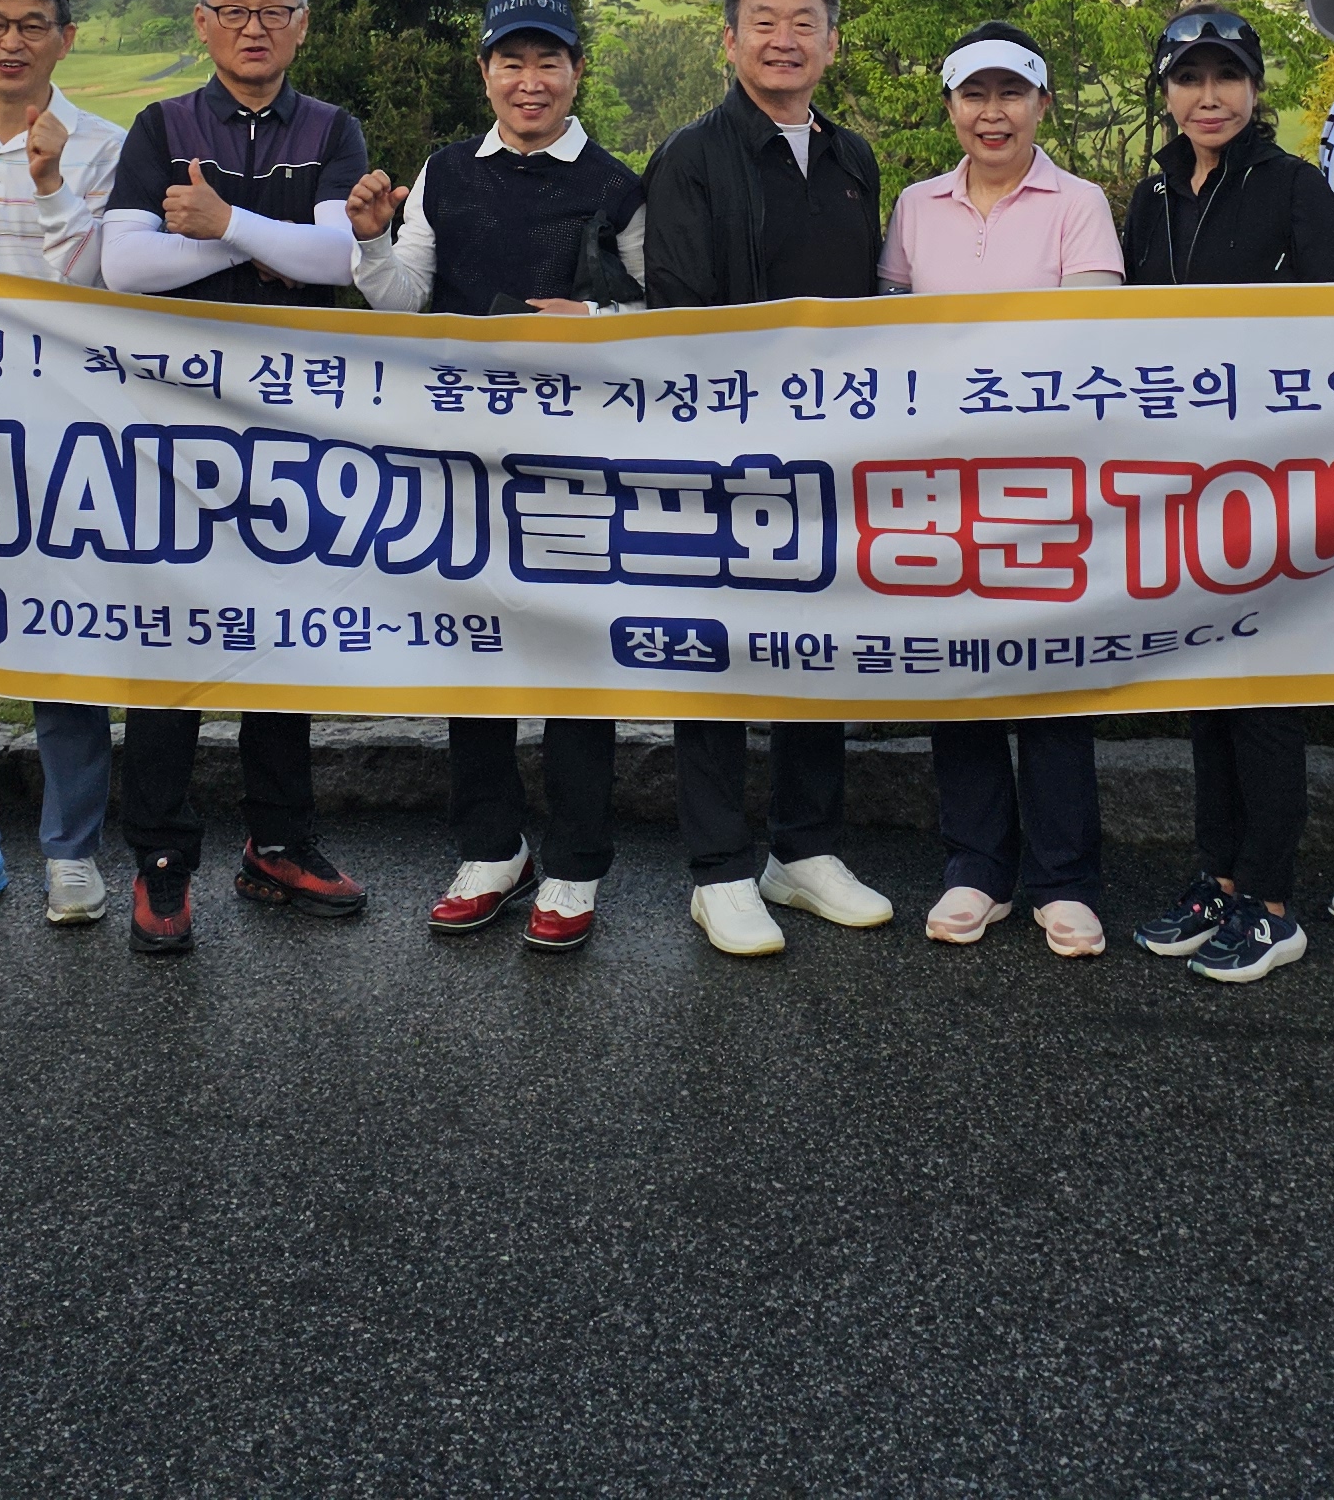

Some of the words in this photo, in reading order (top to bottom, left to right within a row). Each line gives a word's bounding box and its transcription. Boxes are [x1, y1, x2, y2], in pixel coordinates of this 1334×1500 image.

[83, 345, 224, 400] 최고의
[248, 352, 347, 410] 실력
[424, 359, 582, 417] 훌륭한
[602, 369, 759, 425] 지성과
[781, 367, 879, 421] 인성
[959, 362, 1238, 421] 초고수들의
[38, 422, 491, 580] AIP59기
[502, 454, 837, 593] 골프회
[855, 457, 1092, 602] 명문
[21, 597, 173, 648] 2025년
[186, 606, 257, 652] 5월
[273, 606, 503, 653] 16일~18일
[626, 627, 715, 662] 장소
[748, 631, 840, 672] 태안
[853, 611, 1260, 674] 골든베이리조트C.C
